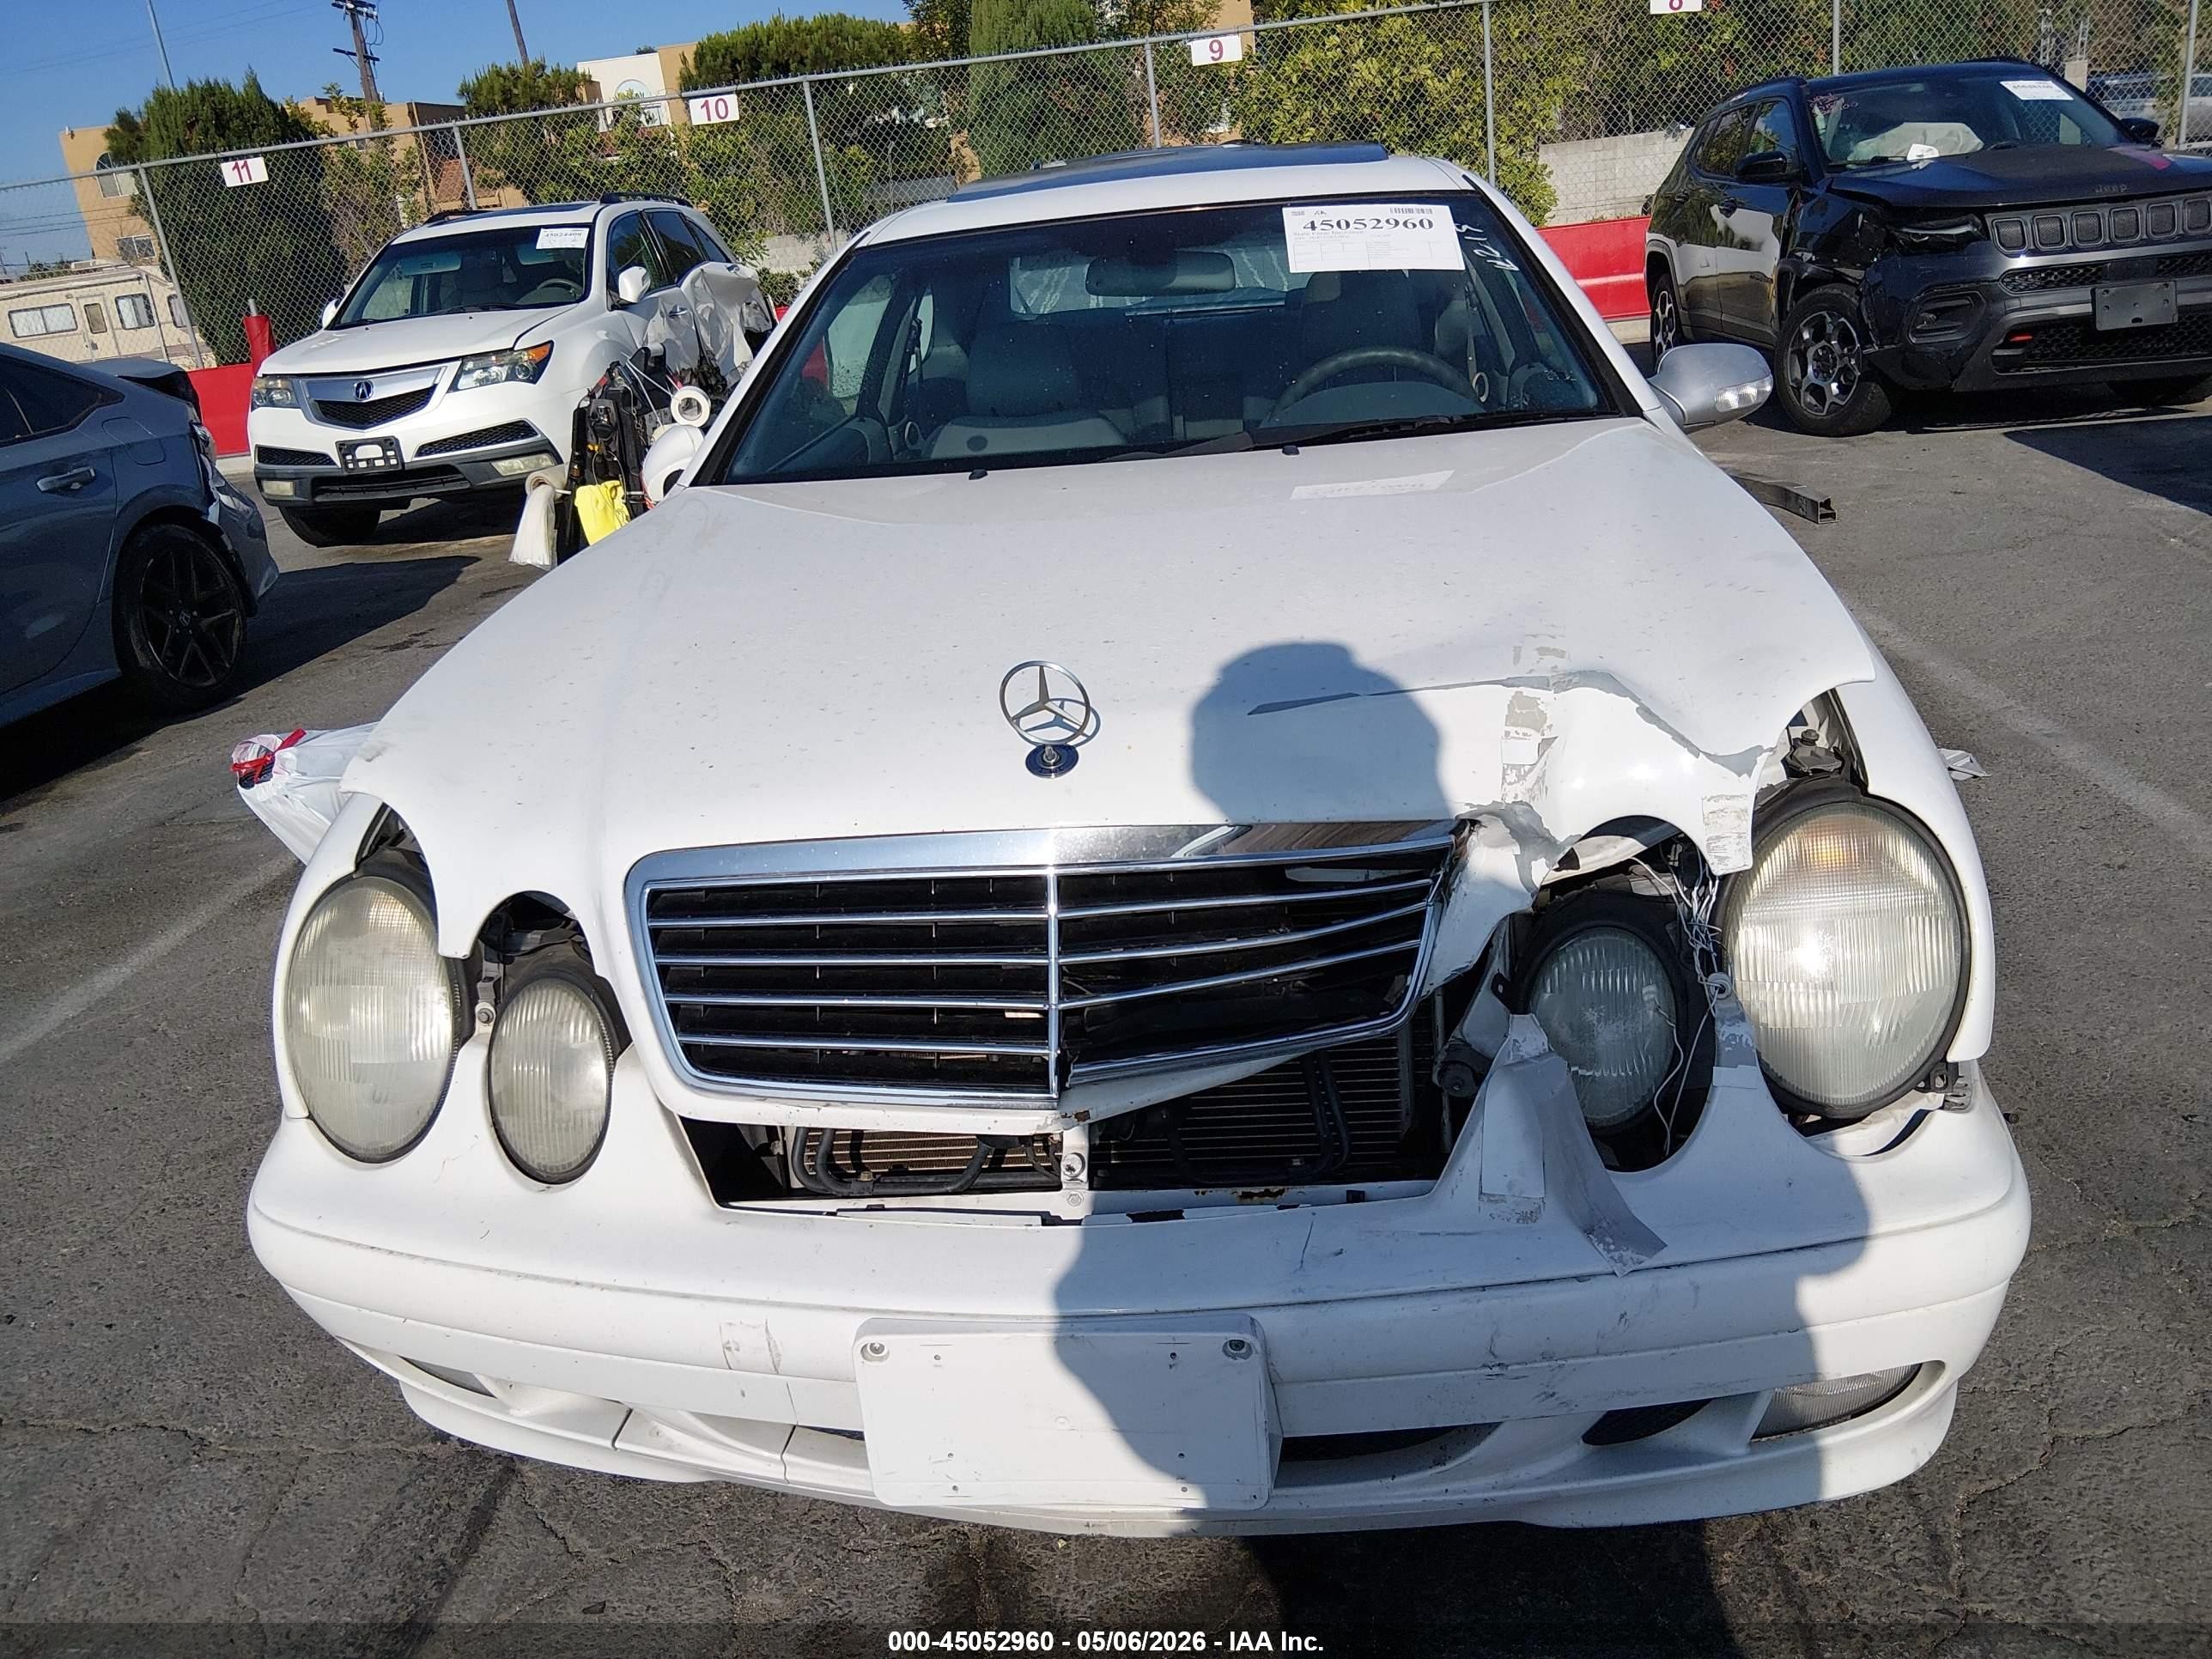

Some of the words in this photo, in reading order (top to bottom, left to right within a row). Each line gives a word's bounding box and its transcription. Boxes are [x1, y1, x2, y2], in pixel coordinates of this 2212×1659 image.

[1209, 40, 1224, 61] 9
[701, 98, 729, 121] 10
[233, 161, 252, 183] 11
[1303, 218, 1434, 231] 45052960
